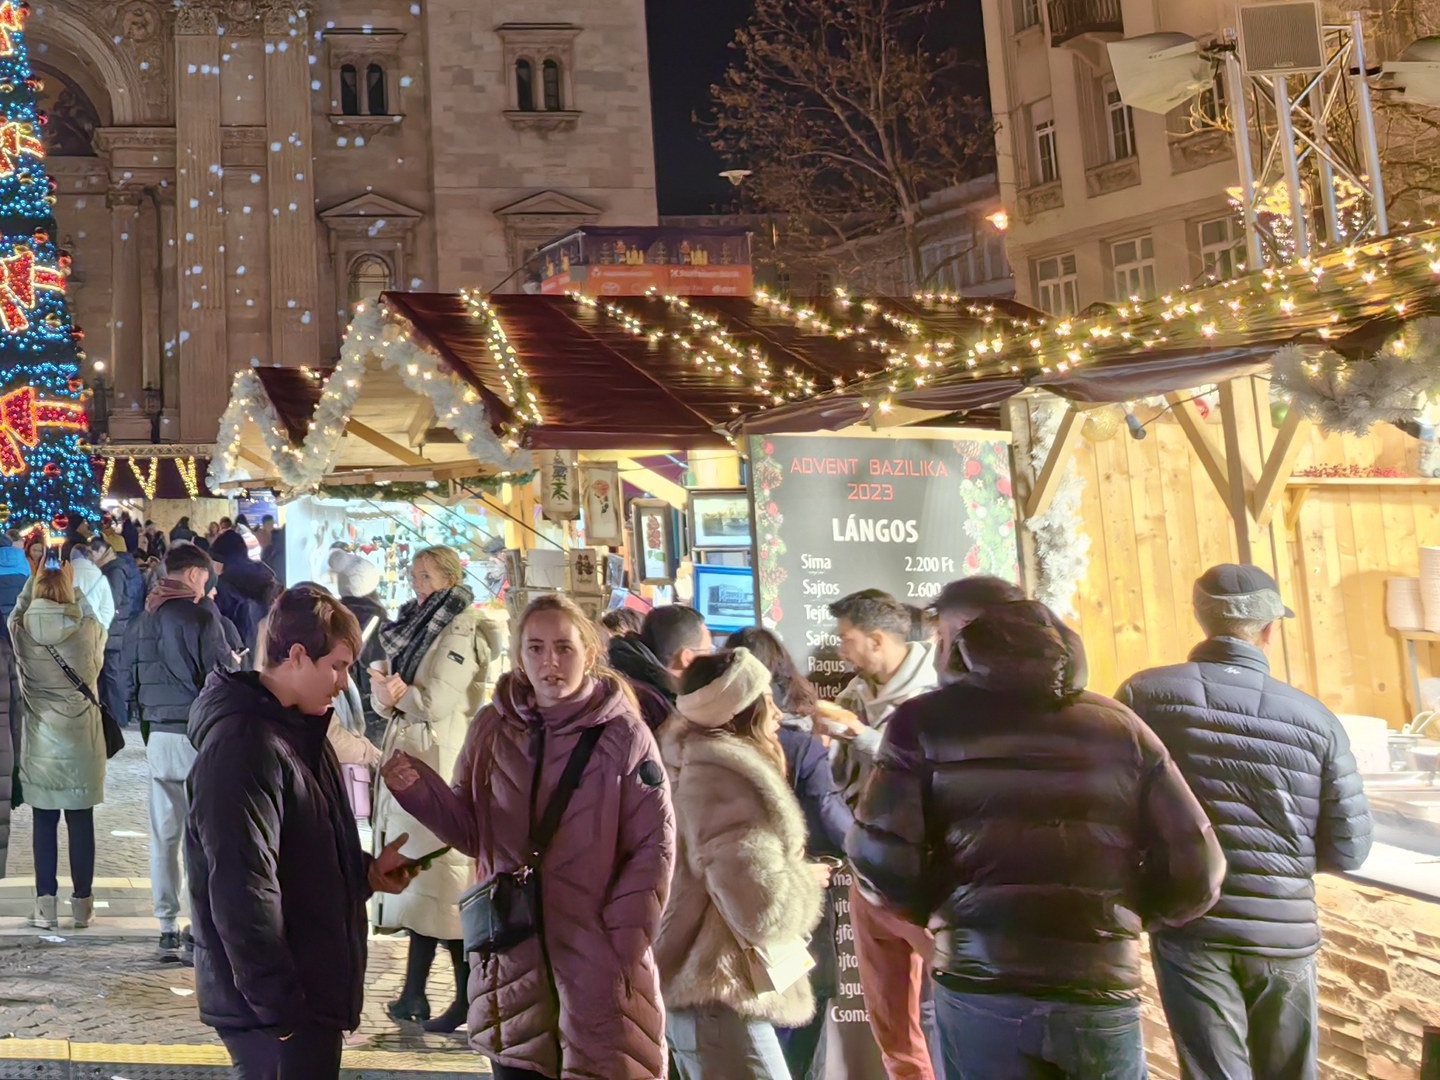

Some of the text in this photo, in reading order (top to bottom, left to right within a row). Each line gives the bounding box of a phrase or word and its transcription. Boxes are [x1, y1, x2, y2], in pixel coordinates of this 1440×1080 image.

[790, 457, 950, 478] ADVENT BAZILIKA
[847, 483, 894, 501] 2023
[832, 513, 919, 544] LÁNGOS
[801, 553, 955, 573] Sima 2.200 Ft
[802, 579, 942, 599] Sajtos 2.600
[808, 656, 846, 676] Ragus
